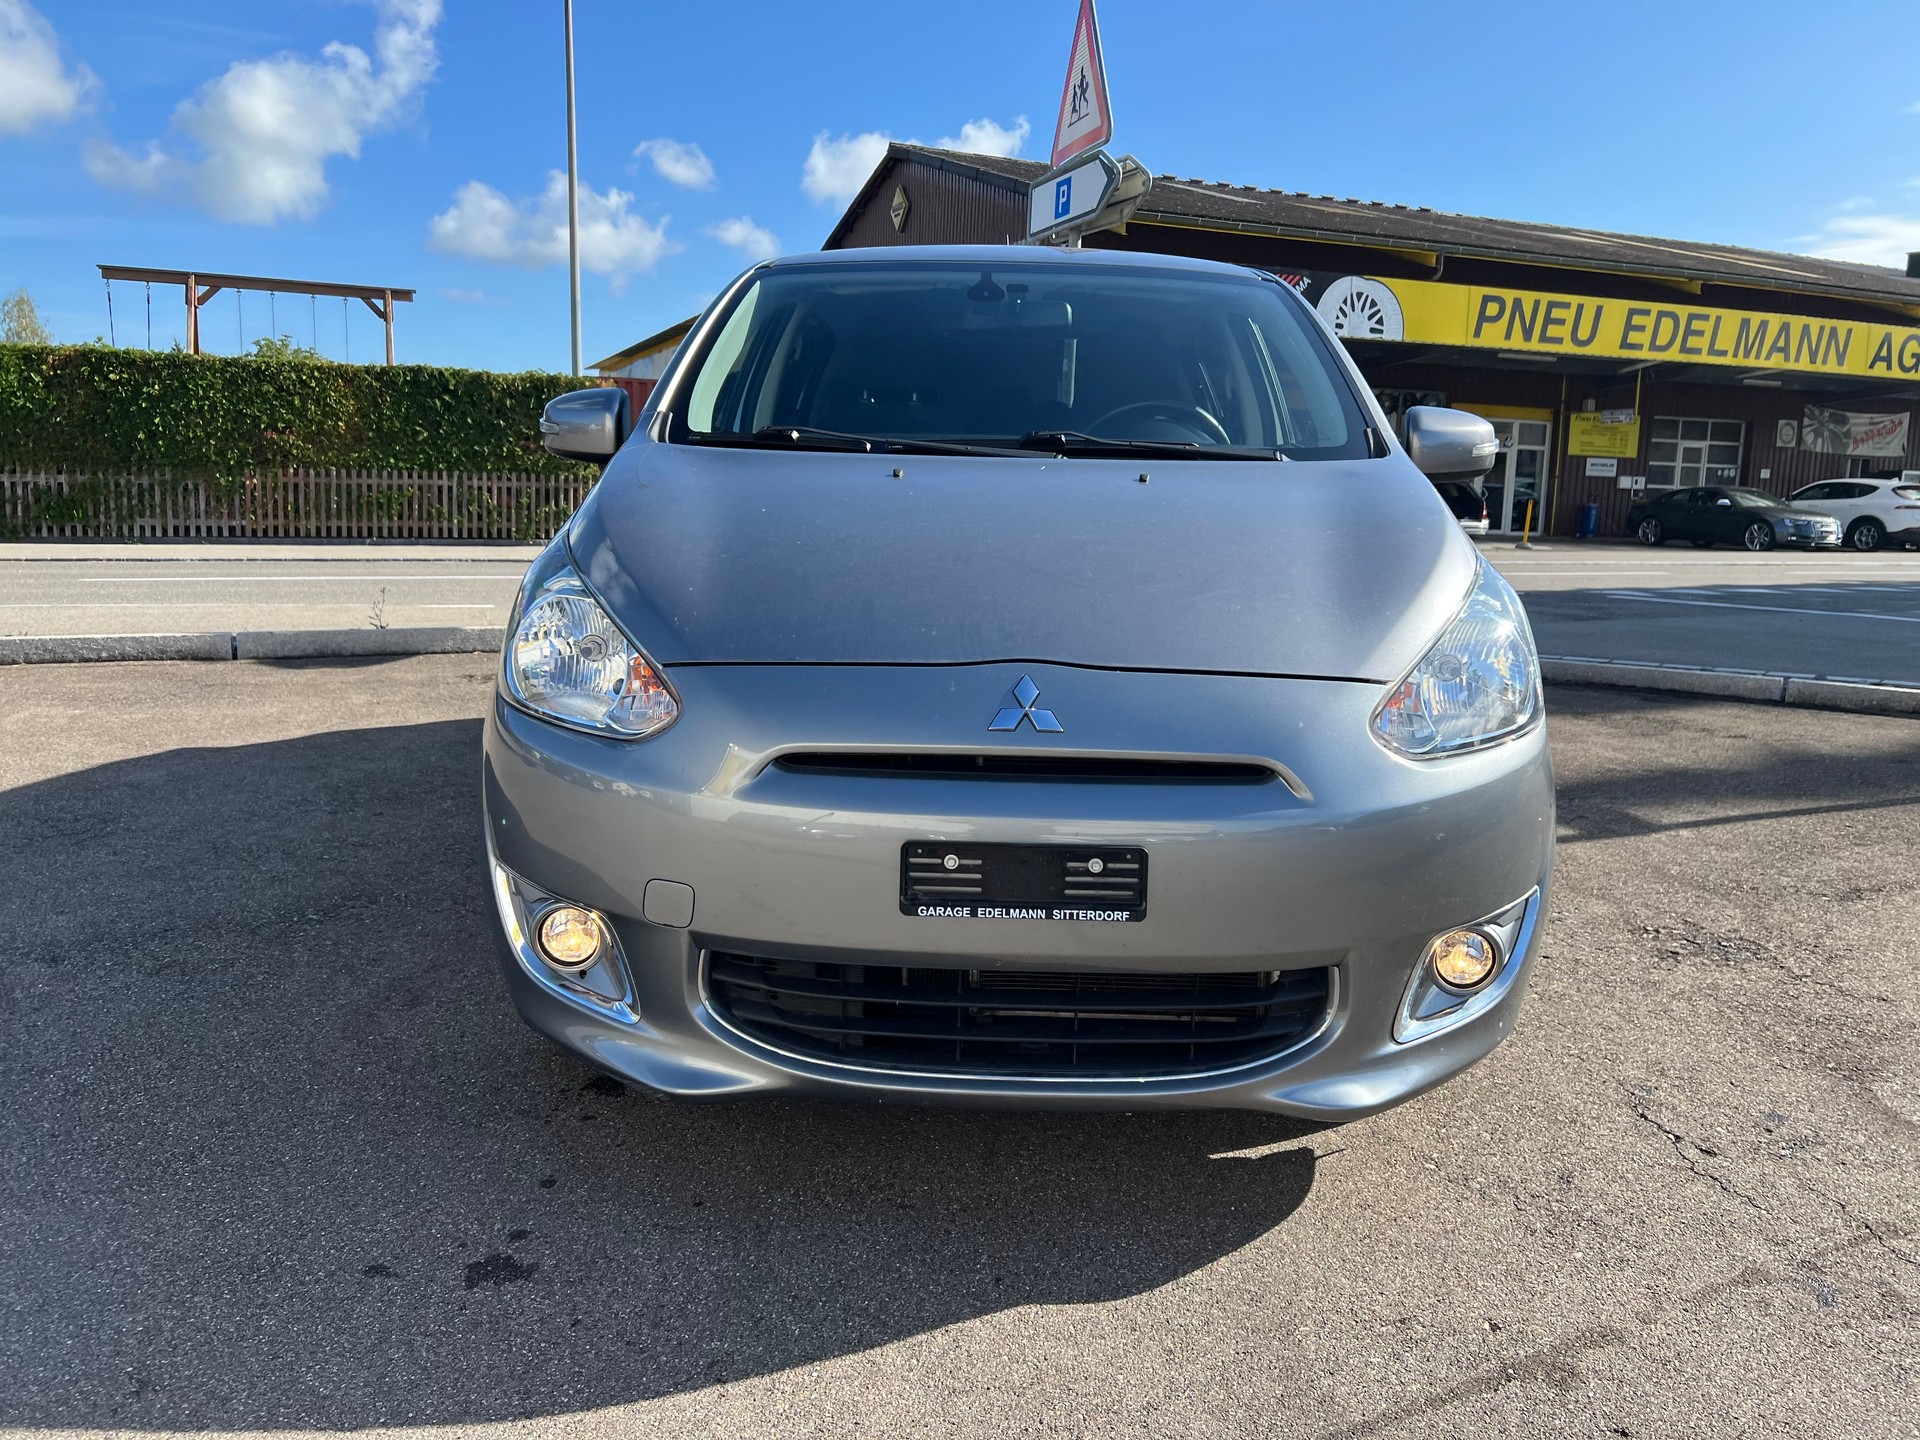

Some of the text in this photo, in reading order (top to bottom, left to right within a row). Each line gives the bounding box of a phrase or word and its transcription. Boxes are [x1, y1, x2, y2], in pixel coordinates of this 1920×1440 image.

[1058, 184, 1068, 213] P
[1473, 294, 1920, 374] PNEU EDELMANN AG
[917, 906, 1130, 921] GARAGE EDELMANN SITTERDORF
